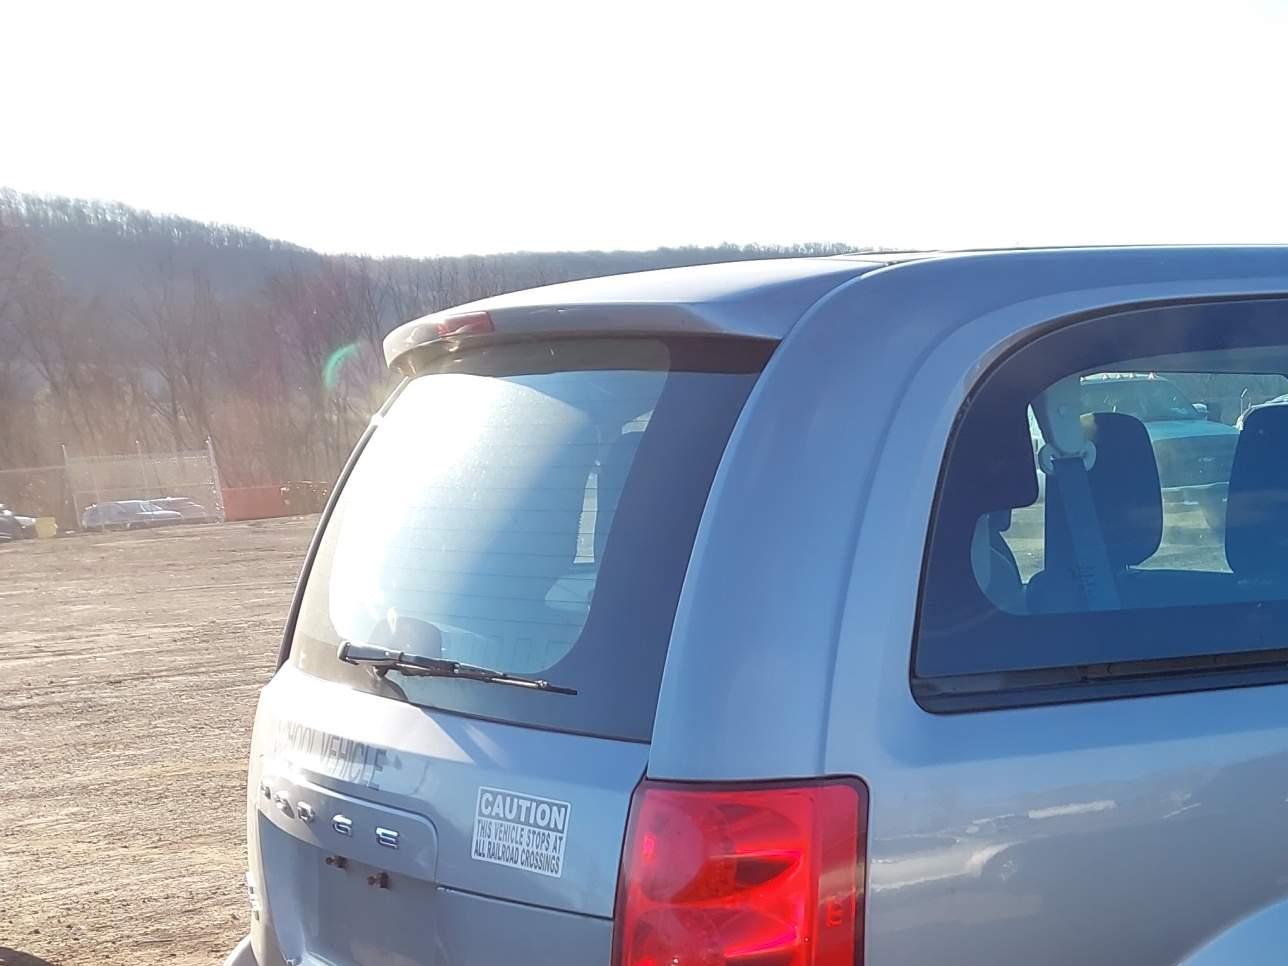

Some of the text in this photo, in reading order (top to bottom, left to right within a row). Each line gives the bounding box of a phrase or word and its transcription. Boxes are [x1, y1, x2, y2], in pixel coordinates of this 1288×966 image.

[480, 792, 567, 831] CAUTION
[478, 818, 564, 854] THIS VEHICLE STOPS AT
[473, 838, 561, 875] ALL RAILROAD CROSSINGS
